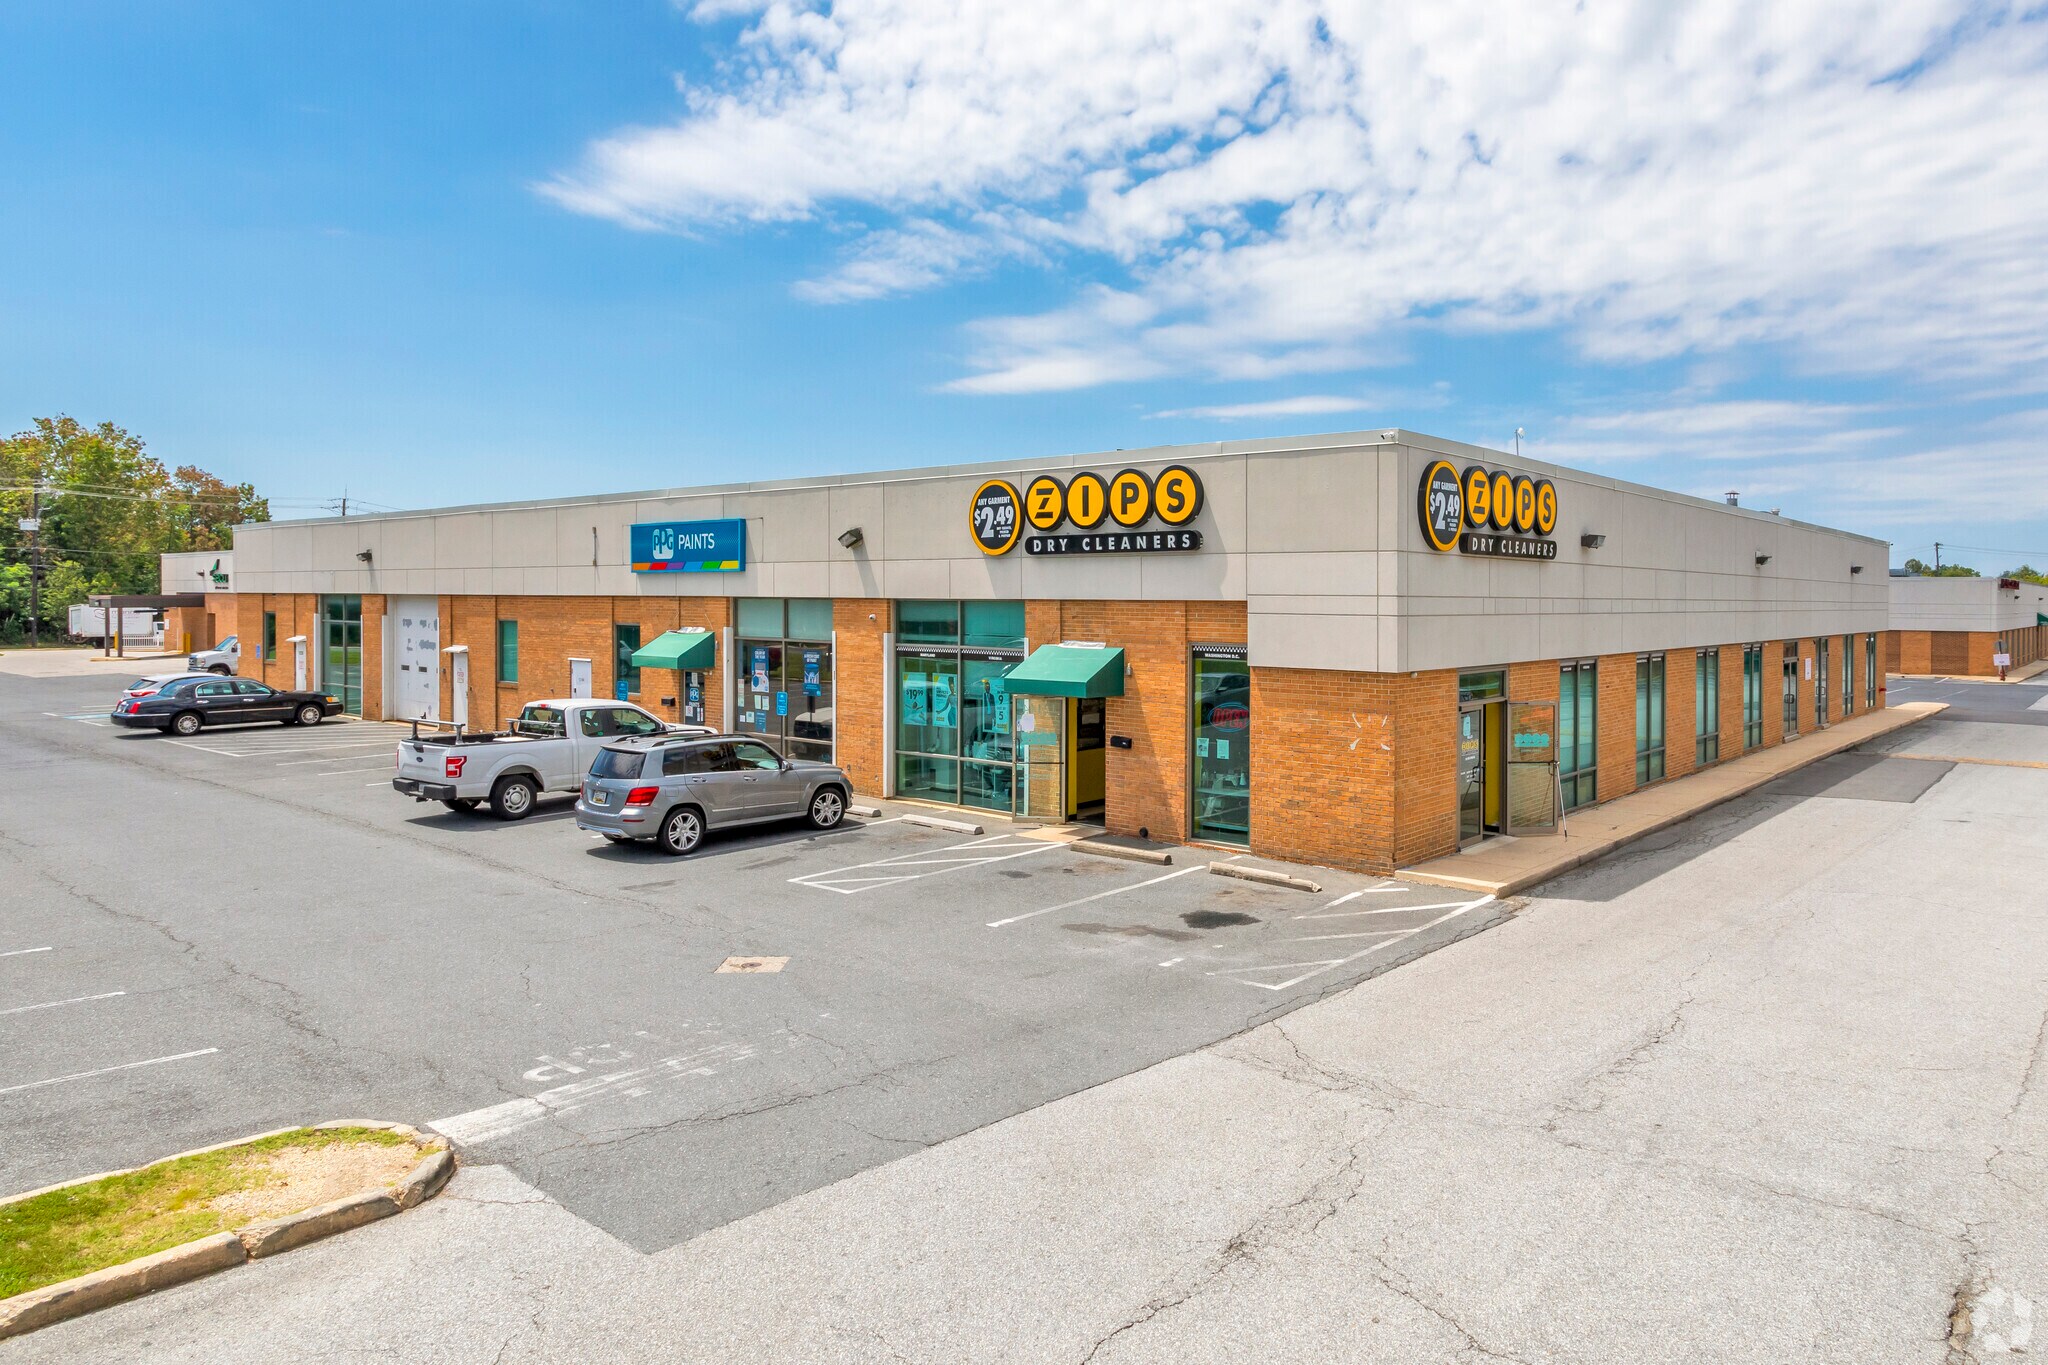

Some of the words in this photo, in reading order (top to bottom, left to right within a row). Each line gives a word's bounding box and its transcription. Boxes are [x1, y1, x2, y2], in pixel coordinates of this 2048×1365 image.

[1432, 480, 1441, 490] ANY
[1441, 481, 1458, 492] GARMENT
[977, 498, 988, 506] ANY
[988, 496, 1011, 505] GARMENT
[1034, 477, 1187, 520] ZIPS
[1472, 479, 1552, 524] ZIPS
[1429, 491, 1460, 530] $2.49
[974, 505, 1014, 538] $2.49
[678, 532, 715, 550] PAINTS
[1033, 538, 1068, 552] DRY
[1082, 533, 1191, 552] CLEANERS
[1472, 537, 1494, 552] DRY
[1501, 539, 1554, 556] CLEANERS
